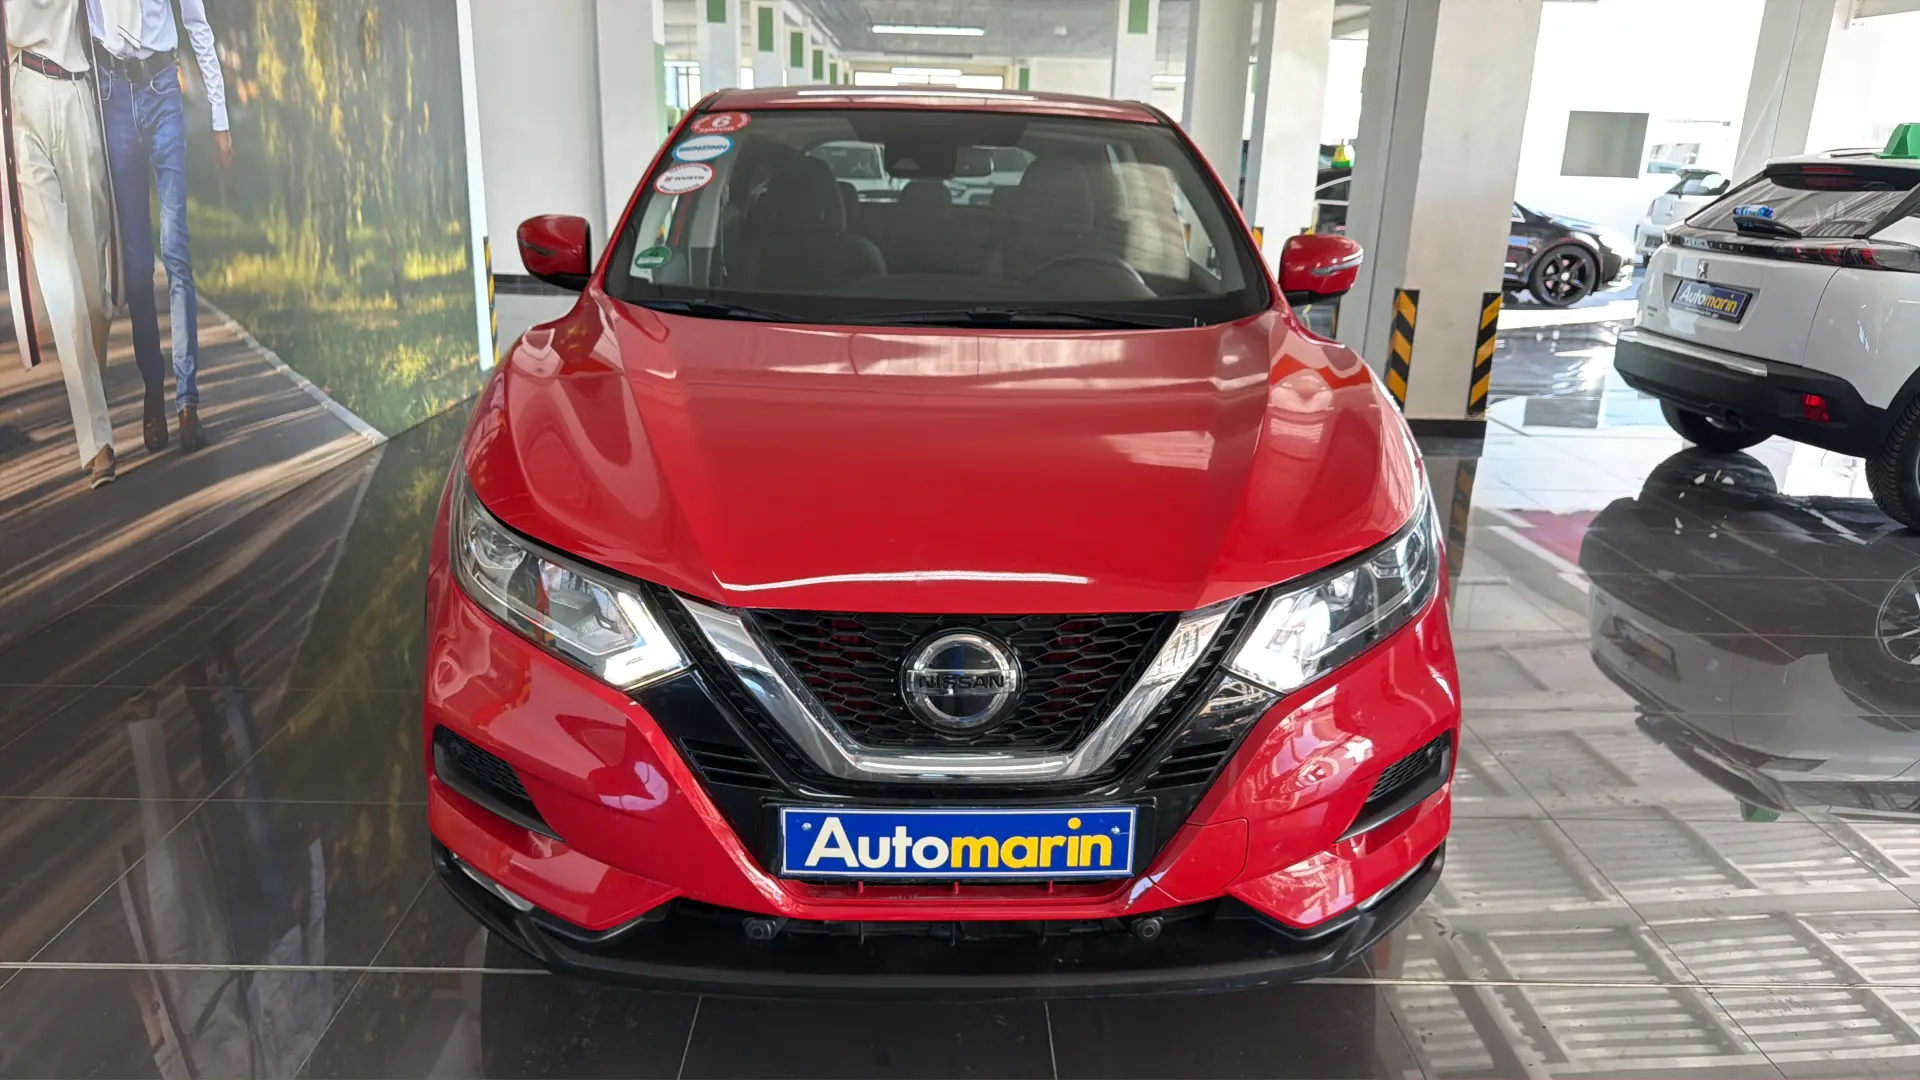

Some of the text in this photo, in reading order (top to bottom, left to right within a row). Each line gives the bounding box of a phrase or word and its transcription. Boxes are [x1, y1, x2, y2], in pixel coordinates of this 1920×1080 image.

[712, 115, 732, 128] 6
[1680, 284, 1738, 312] Automarin
[919, 674, 1005, 690] NISSAN
[804, 816, 1112, 869] Automarin
